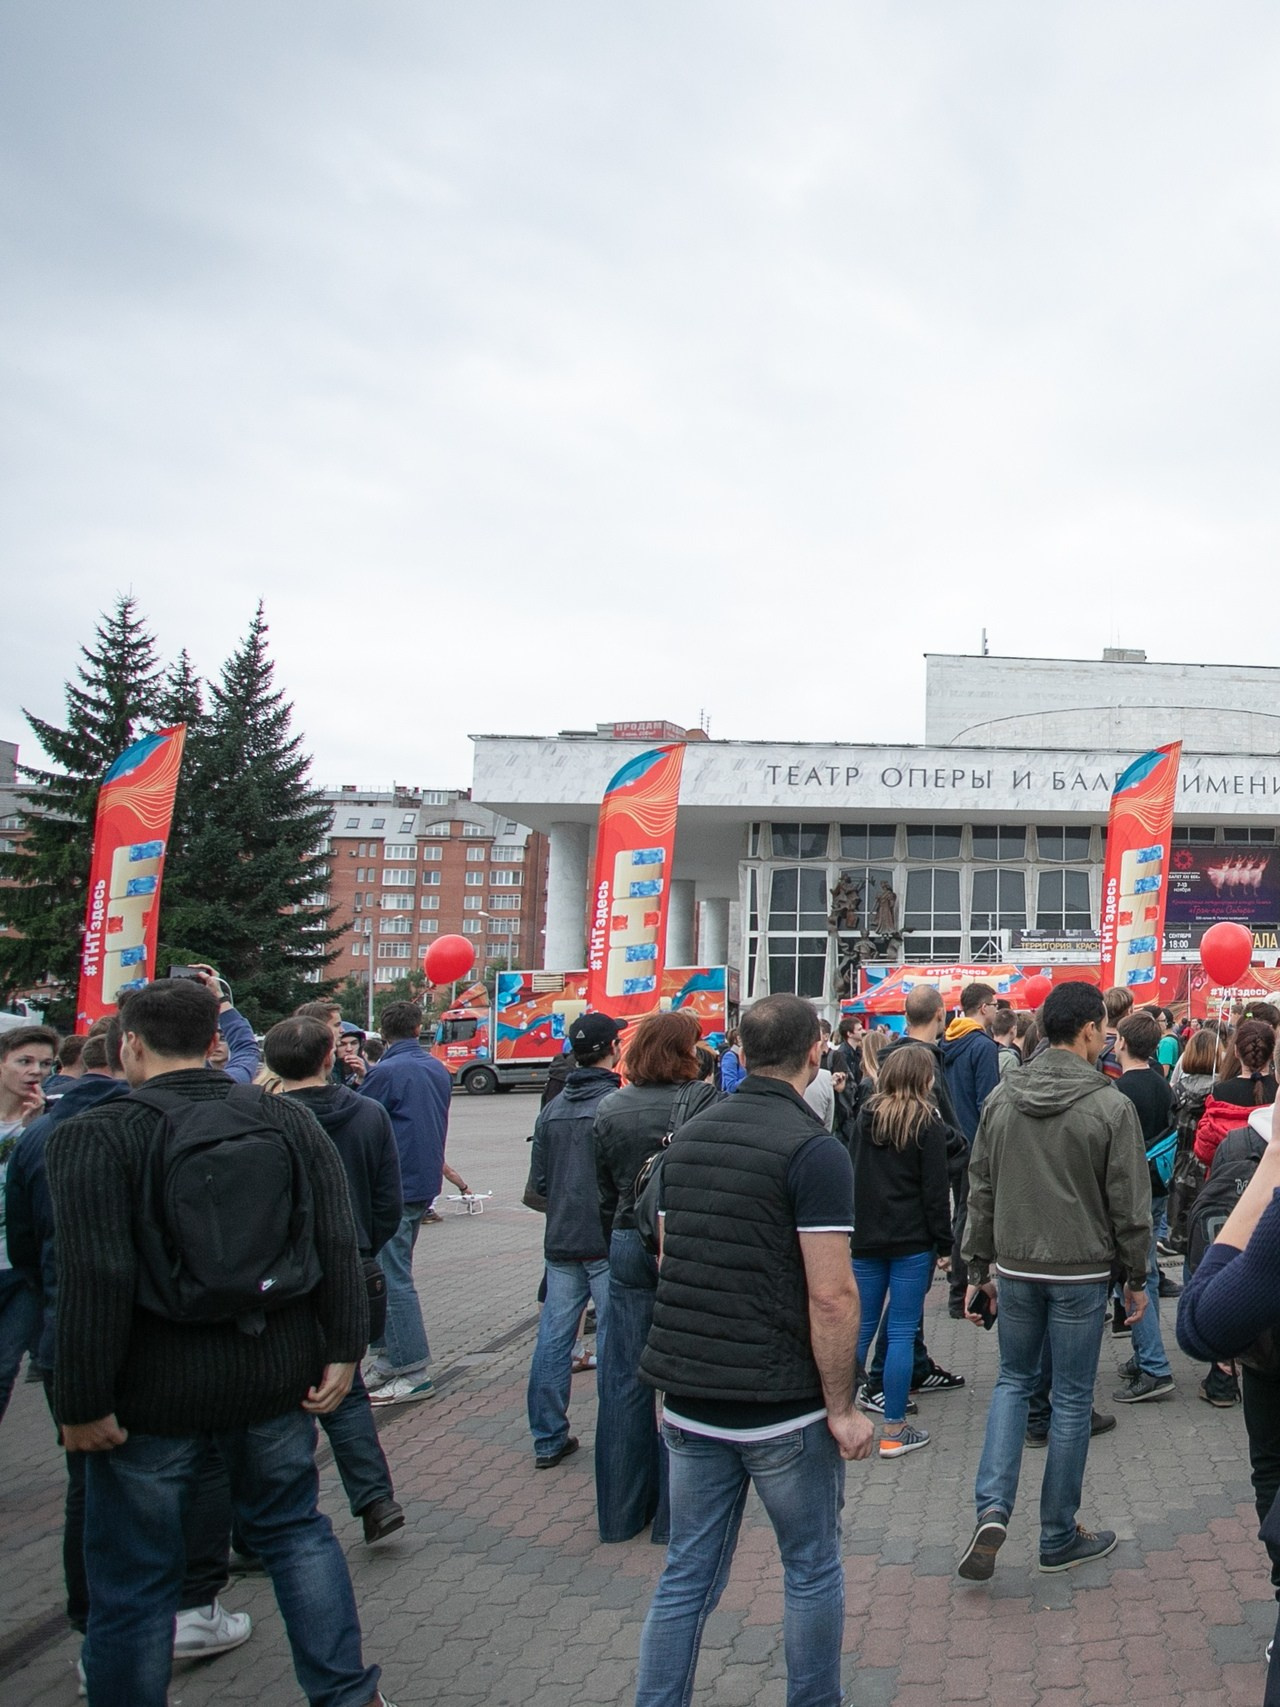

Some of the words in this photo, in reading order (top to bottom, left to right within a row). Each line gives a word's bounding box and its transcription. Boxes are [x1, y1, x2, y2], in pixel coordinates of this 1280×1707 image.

[767, 766, 860, 787] ТЕАТР
[881, 767, 991, 789] ОПЕРЫ
[1012, 771, 1031, 790] И
[1052, 772, 1118, 791] БАЛ
[83, 879, 106, 977] #ТНТздесь
[590, 880, 609, 971] #ТНТздесь
[1102, 878, 1117, 963] #ТНТздесь
[1075, 942, 1100, 950] КРАСН
[1168, 939, 1189, 948] 18:00
[1210, 987, 1268, 997] #ТНТздесь
